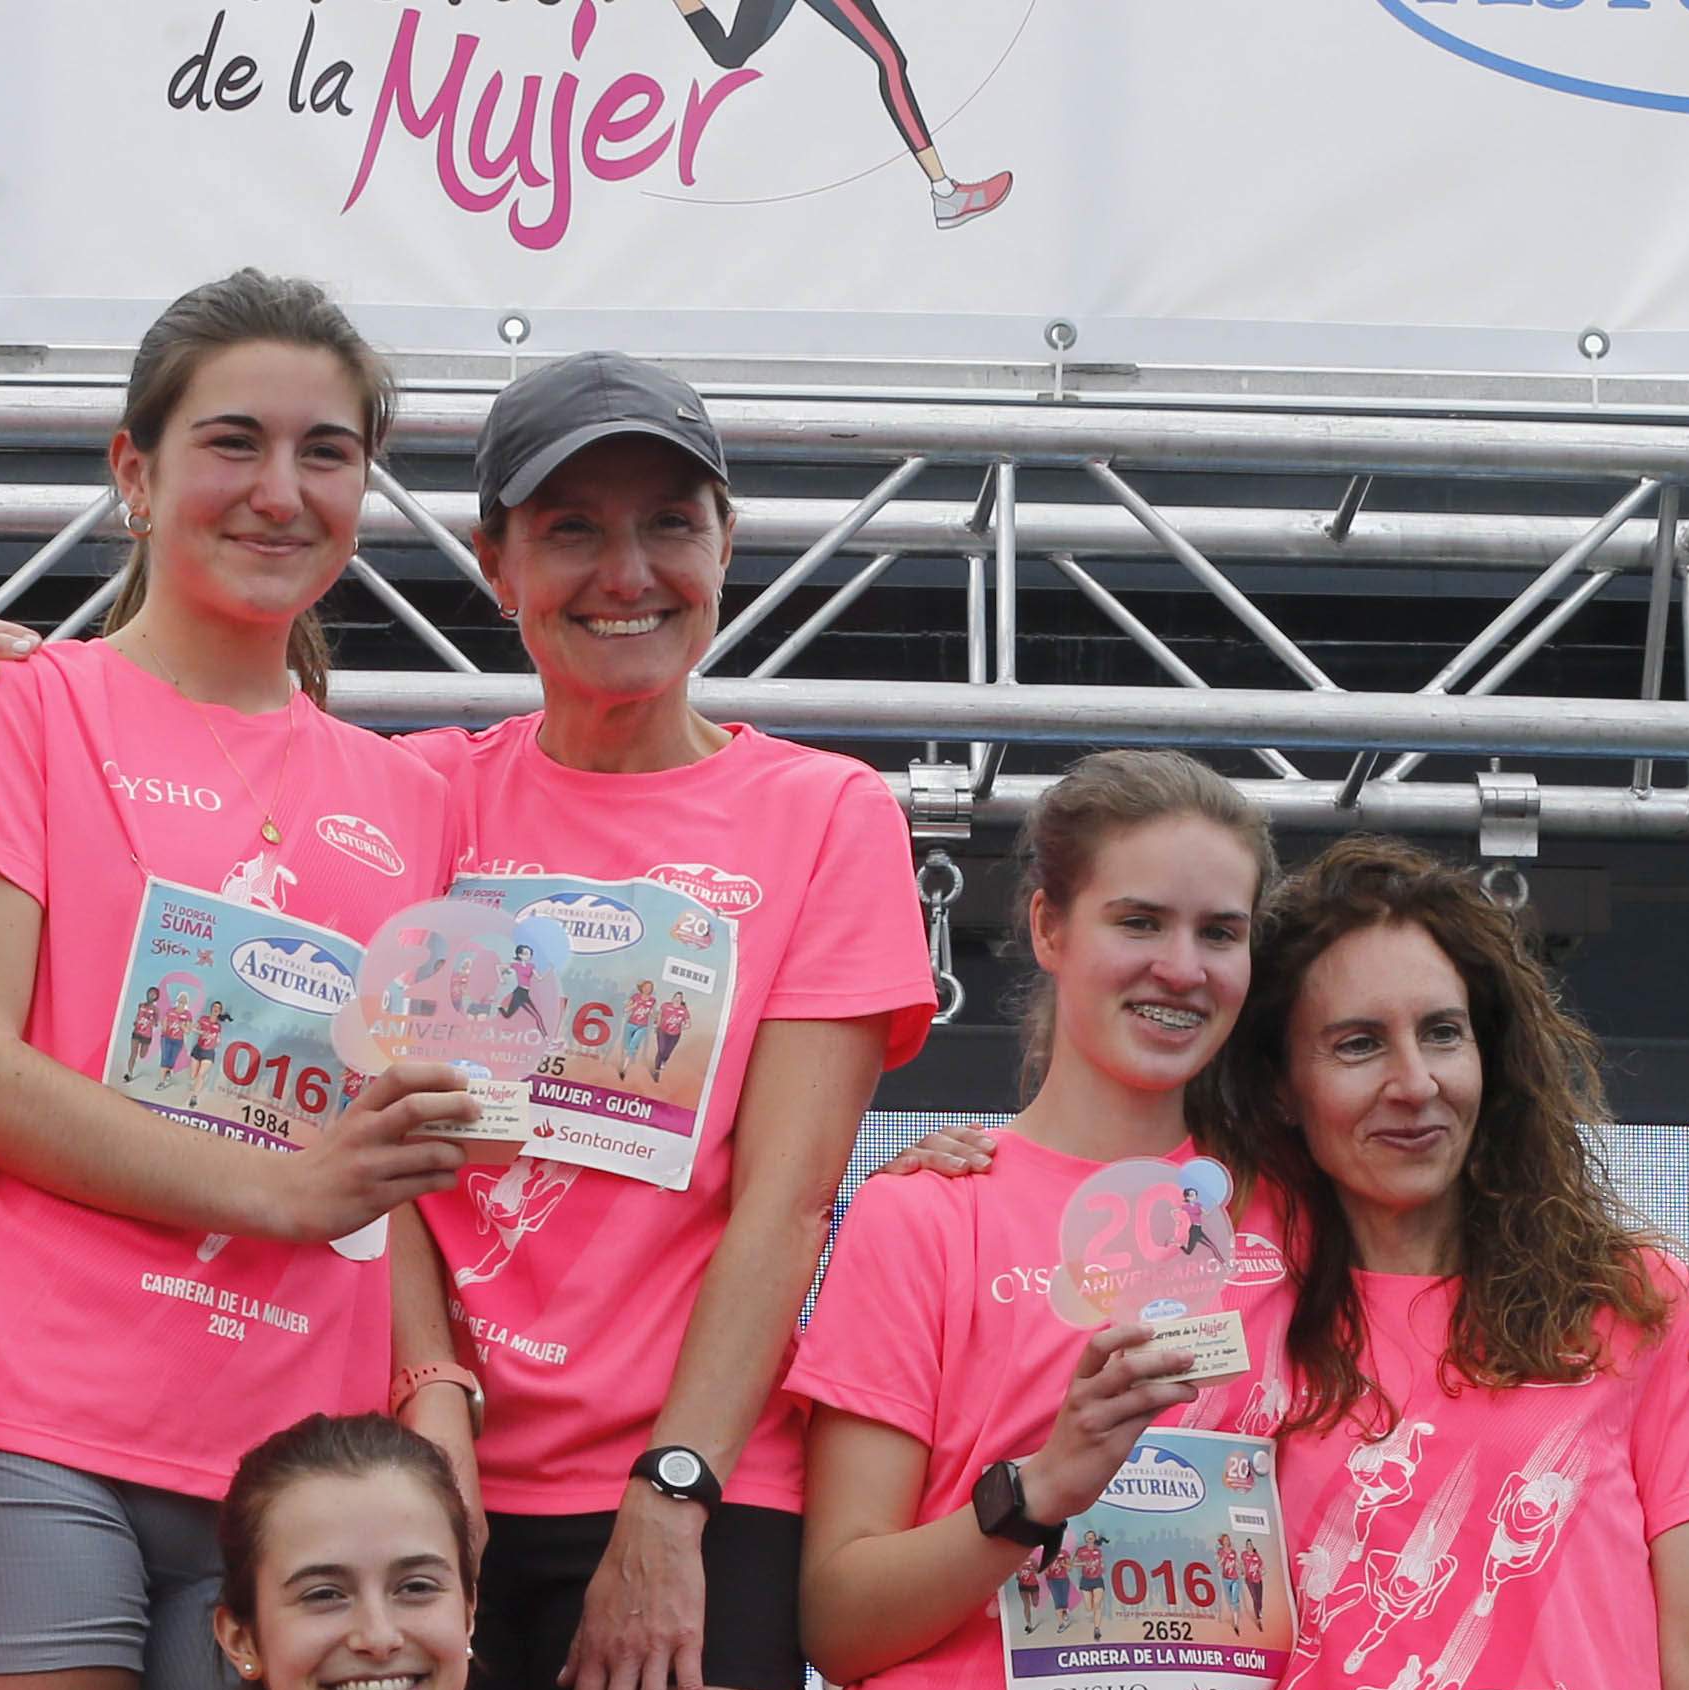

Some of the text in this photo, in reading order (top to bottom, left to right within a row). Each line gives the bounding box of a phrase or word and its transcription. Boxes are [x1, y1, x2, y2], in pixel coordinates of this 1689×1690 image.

[167, 0, 763, 251] de la Mujer
[473, 889, 506, 898] DORSAL
[161, 914, 214, 940] SUMA
[162, 902, 217, 925] TU DORSAL
[680, 913, 709, 936] 20
[264, 952, 308, 972] CENTRAL
[223, 1041, 331, 1114] 016
[538, 1081, 592, 1106] MUJER
[606, 1096, 652, 1119] GIJÓN
[242, 1105, 290, 1138] 1984
[557, 1126, 656, 1160] Santander
[1082, 1184, 1191, 1270] 20
[141, 1272, 310, 1335] CARRERA DE LA MUJER
[207, 1314, 246, 1342] 2024
[487, 1321, 508, 1346] LA
[509, 1331, 568, 1365] MUJER
[1227, 1457, 1250, 1478] 20
[1111, 1559, 1216, 1608] 016
[1143, 1621, 1194, 1641] 2652
[1057, 1649, 1266, 1670] CARRERA DE LA MUJER GIJÓN
